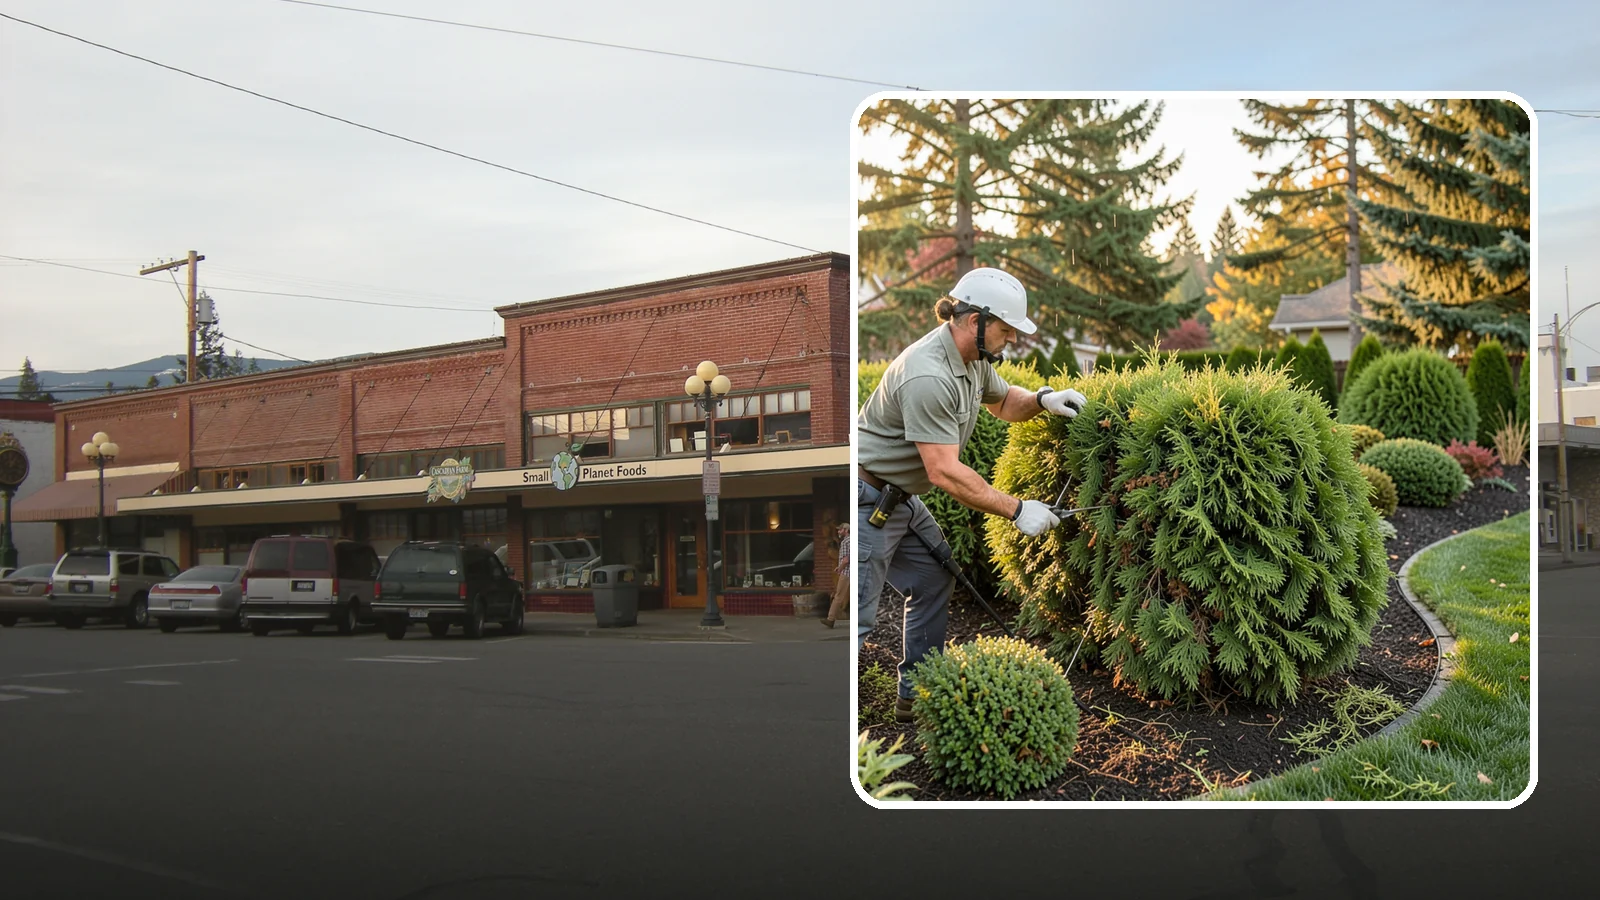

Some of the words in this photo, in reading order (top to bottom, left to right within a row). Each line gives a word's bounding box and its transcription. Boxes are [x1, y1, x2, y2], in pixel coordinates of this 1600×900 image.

[431, 467, 455, 476] CASCADIAN
[455, 466, 469, 474] FARM
[523, 471, 549, 483] Small
[583, 467, 613, 479] Planet
[617, 465, 647, 477] Foods
